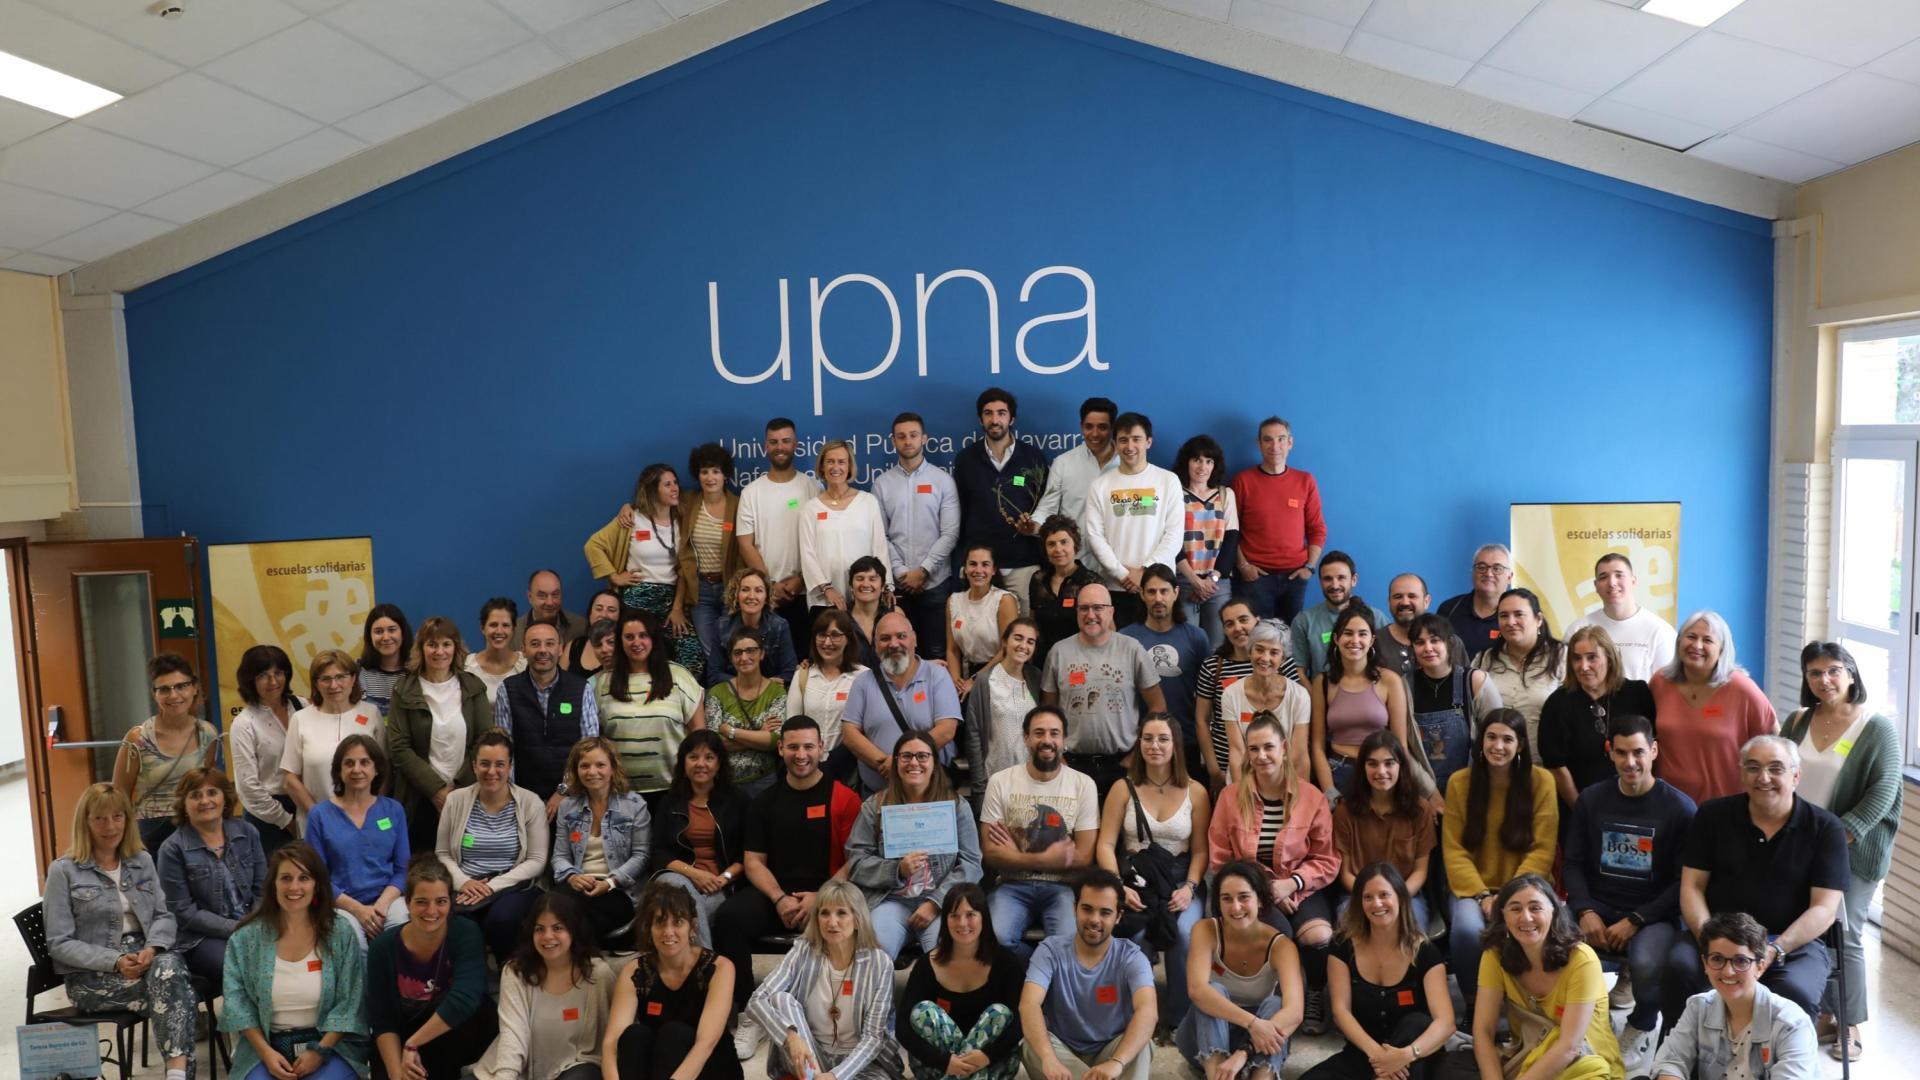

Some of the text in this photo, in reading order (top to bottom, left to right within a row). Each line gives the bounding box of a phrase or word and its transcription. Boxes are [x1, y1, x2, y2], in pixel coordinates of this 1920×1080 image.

[708, 265, 1110, 417] upna
[719, 434, 857, 459] Univsidd
[866, 433, 953, 455] Púca
[1567, 527, 1672, 540] escuelas solidarias
[266, 561, 366, 577] escuelas solidarias
